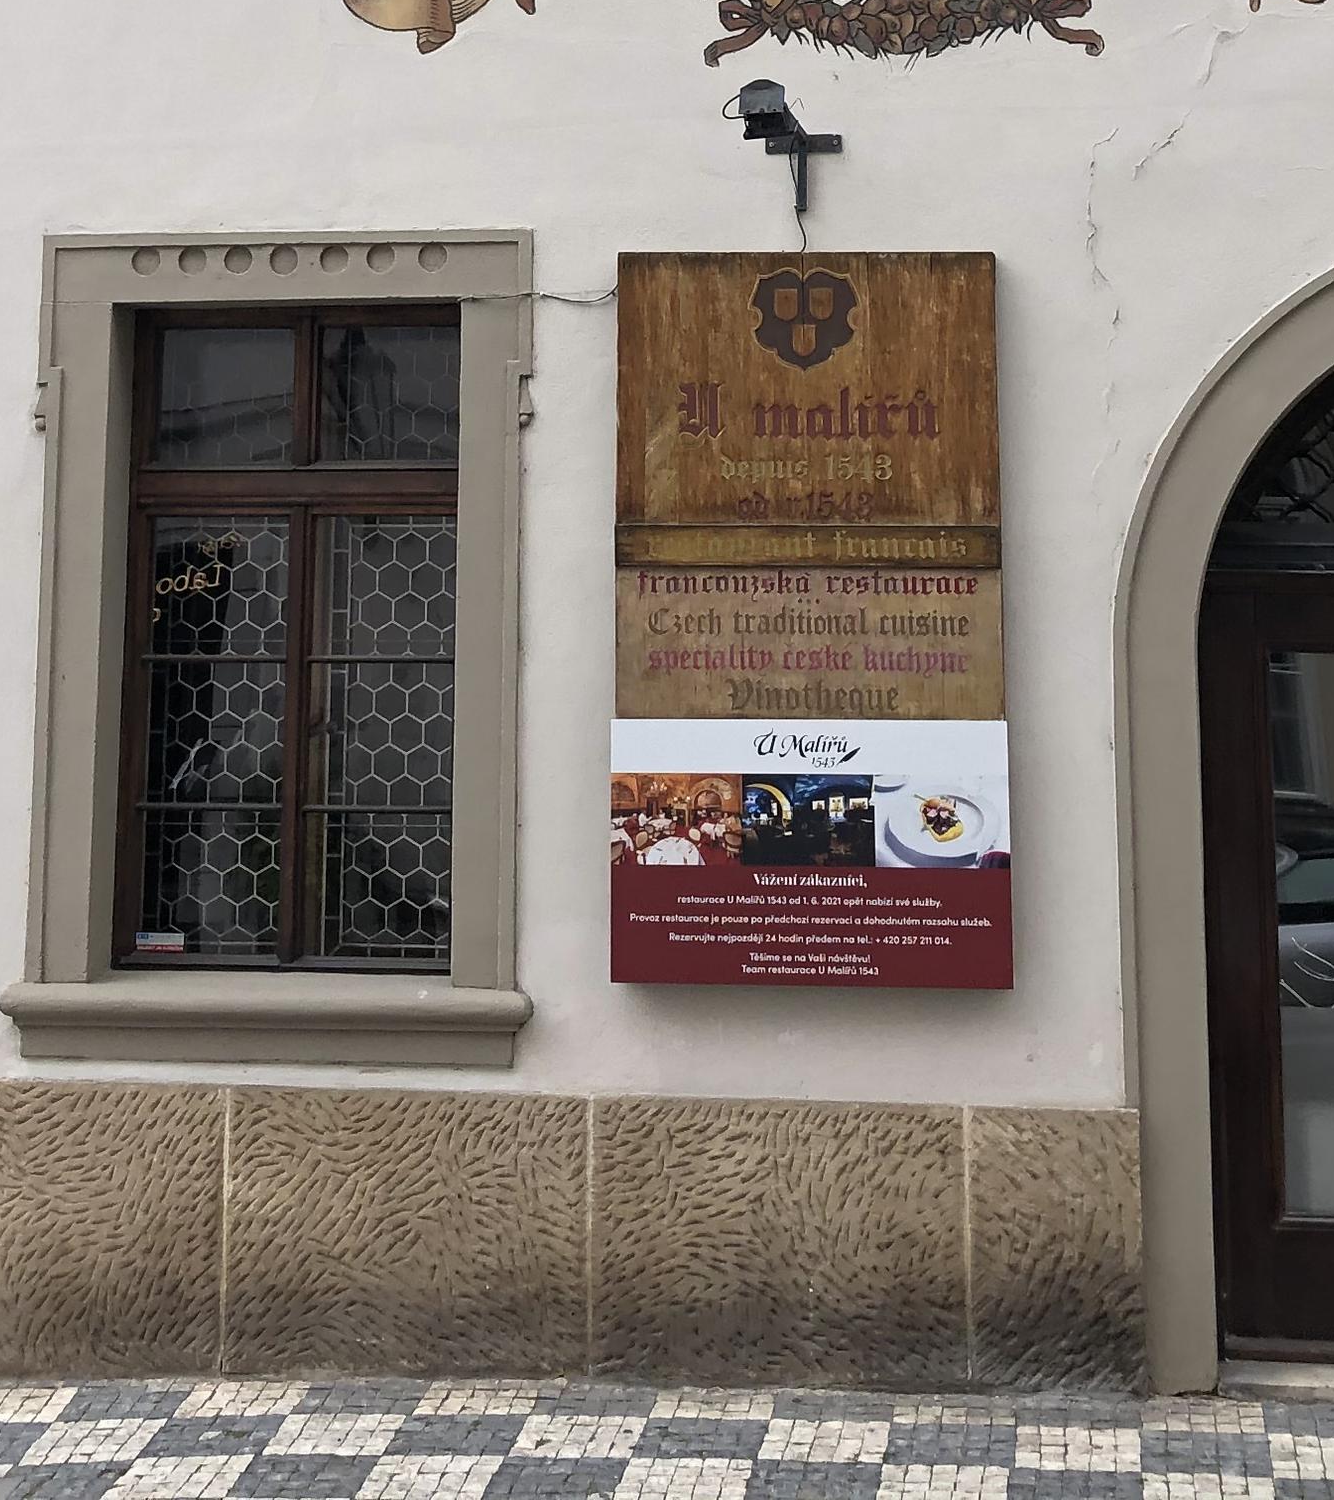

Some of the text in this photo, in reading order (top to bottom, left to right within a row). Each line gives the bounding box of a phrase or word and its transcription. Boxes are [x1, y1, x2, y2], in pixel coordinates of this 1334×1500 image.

[676, 380, 942, 444] U malířů
[719, 453, 894, 484] depuis 1543
[647, 530, 816, 559] rtaurant
[637, 569, 979, 601] francouzská restaurace
[648, 605, 970, 637] Czech traditional cuisine
[725, 676, 900, 715] Vinotheque
[753, 727, 849, 758] U Malířů
[811, 757, 836, 769] 1543
[753, 873, 868, 888] Vážení zákazníci,
[677, 895, 725, 904] restaurace
[727, 895, 734, 904] U
[736, 895, 765, 904] Malířů
[767, 895, 787, 905] 1543
[789, 895, 801, 905] od
[821, 896, 842, 906] 2021
[843, 897, 864, 908] opět
[895, 897, 910, 907] své
[629, 913, 660, 923] Provoz
[661, 913, 709, 923] restaurace
[710, 914, 720, 925] je
[721, 915, 749, 926] pouze
[750, 916, 763, 926] po
[811, 915, 853, 925] rezervaci
[863, 916, 921, 926] dohodnutém
[960, 917, 993, 928] služeb.
[669, 932, 716, 944] Rezervujte
[717, 933, 764, 944] nejpozději
[765, 934, 777, 943] 24
[778, 933, 804, 943] hodin
[805, 935, 841, 945] předem
[843, 936, 855, 944] na
[882, 935, 900, 945] 420
[901, 935, 918, 945] 257
[919, 935, 933, 945] 211
[934, 936, 953, 946] 014.
[749, 952, 780, 962] Těšíme
[782, 954, 793, 962] se
[794, 954, 807, 962] na
[741, 964, 879, 976] Team restaurace U Malířů 1543
